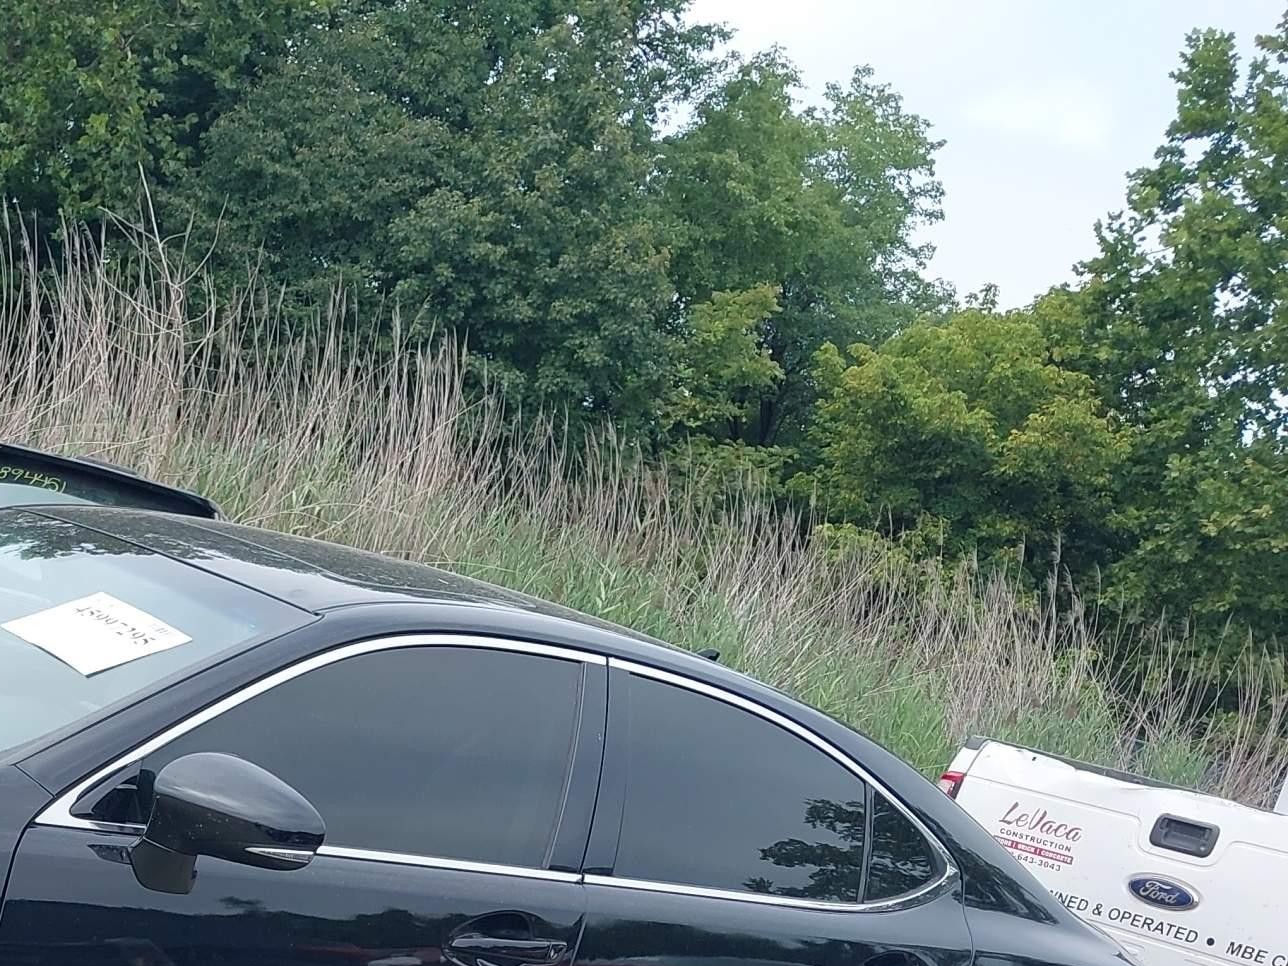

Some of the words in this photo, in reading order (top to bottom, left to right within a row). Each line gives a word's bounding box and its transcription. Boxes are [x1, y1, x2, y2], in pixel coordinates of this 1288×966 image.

[999, 827, 1072, 852] CONSTRUCTION
[1139, 880, 1180, 904] Ford
[1092, 903, 1103, 917] &
[1108, 907, 1199, 943] OPERATED
[1225, 941, 1269, 964] MBE
